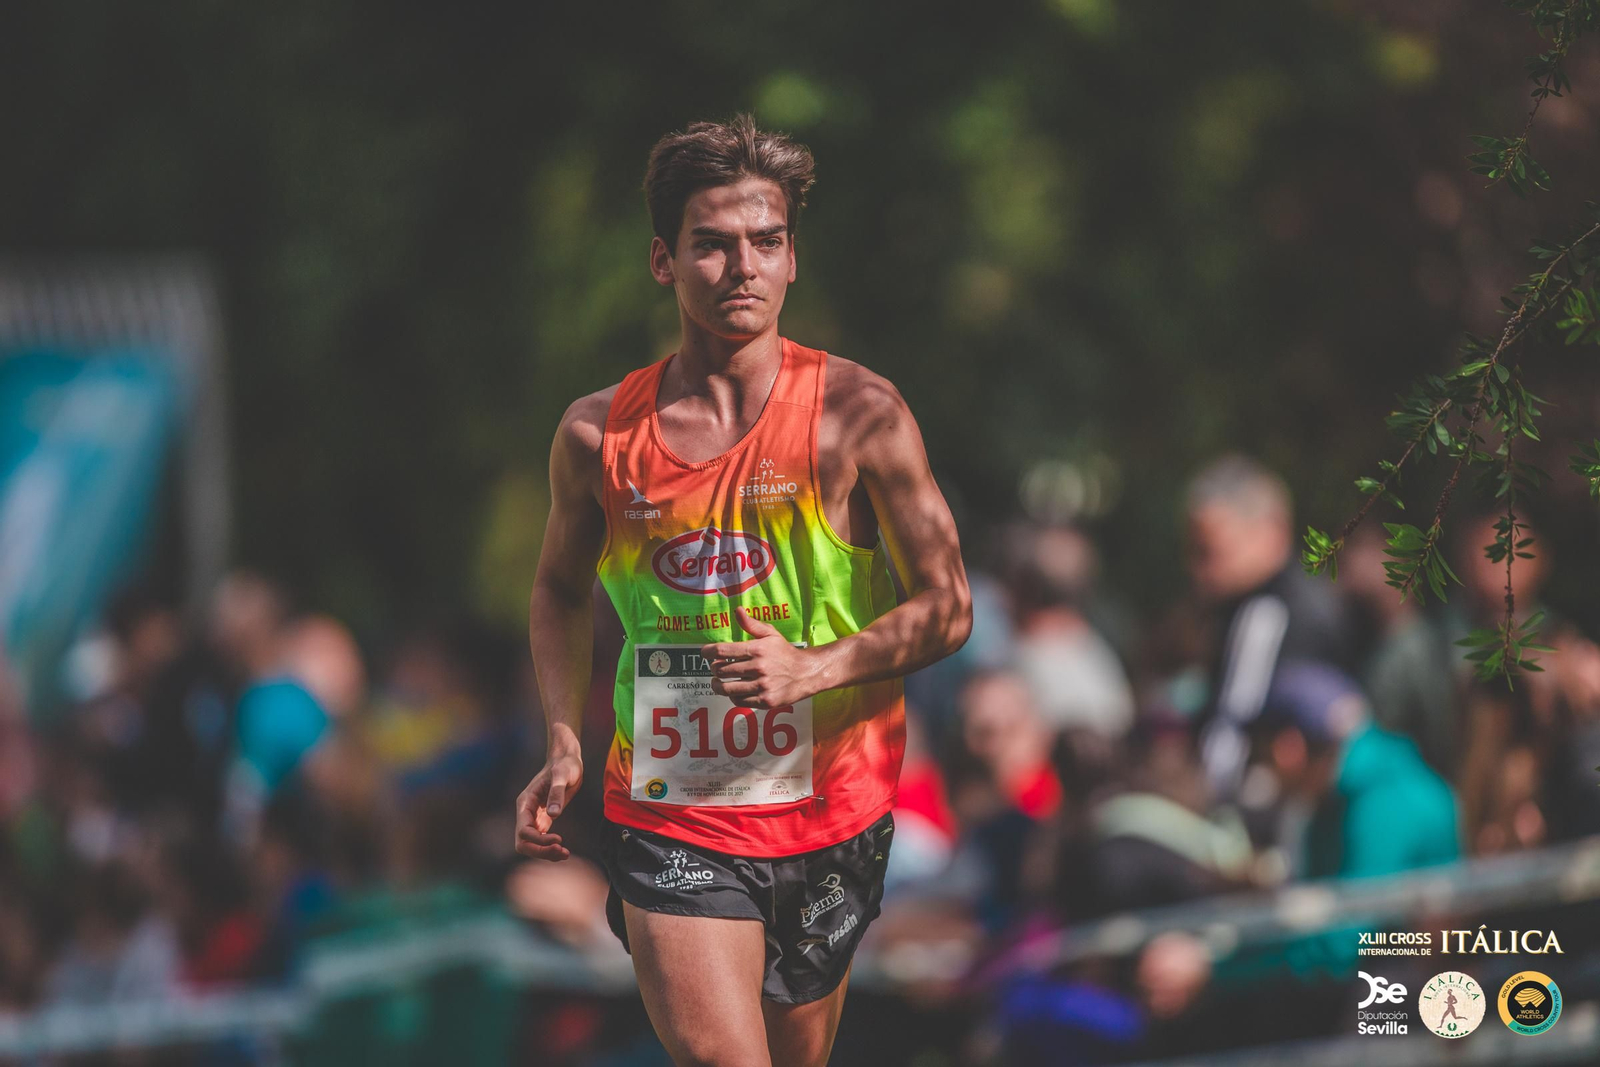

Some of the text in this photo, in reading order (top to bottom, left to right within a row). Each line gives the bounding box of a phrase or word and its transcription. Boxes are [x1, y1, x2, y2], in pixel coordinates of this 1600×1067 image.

[738, 482, 798, 497] SERRANO
[666, 548, 764, 579] Serrano
[657, 615, 691, 631] COME
[695, 612, 730, 631] BIEN
[651, 706, 798, 759] 5106
[801, 891, 843, 923] Perna
